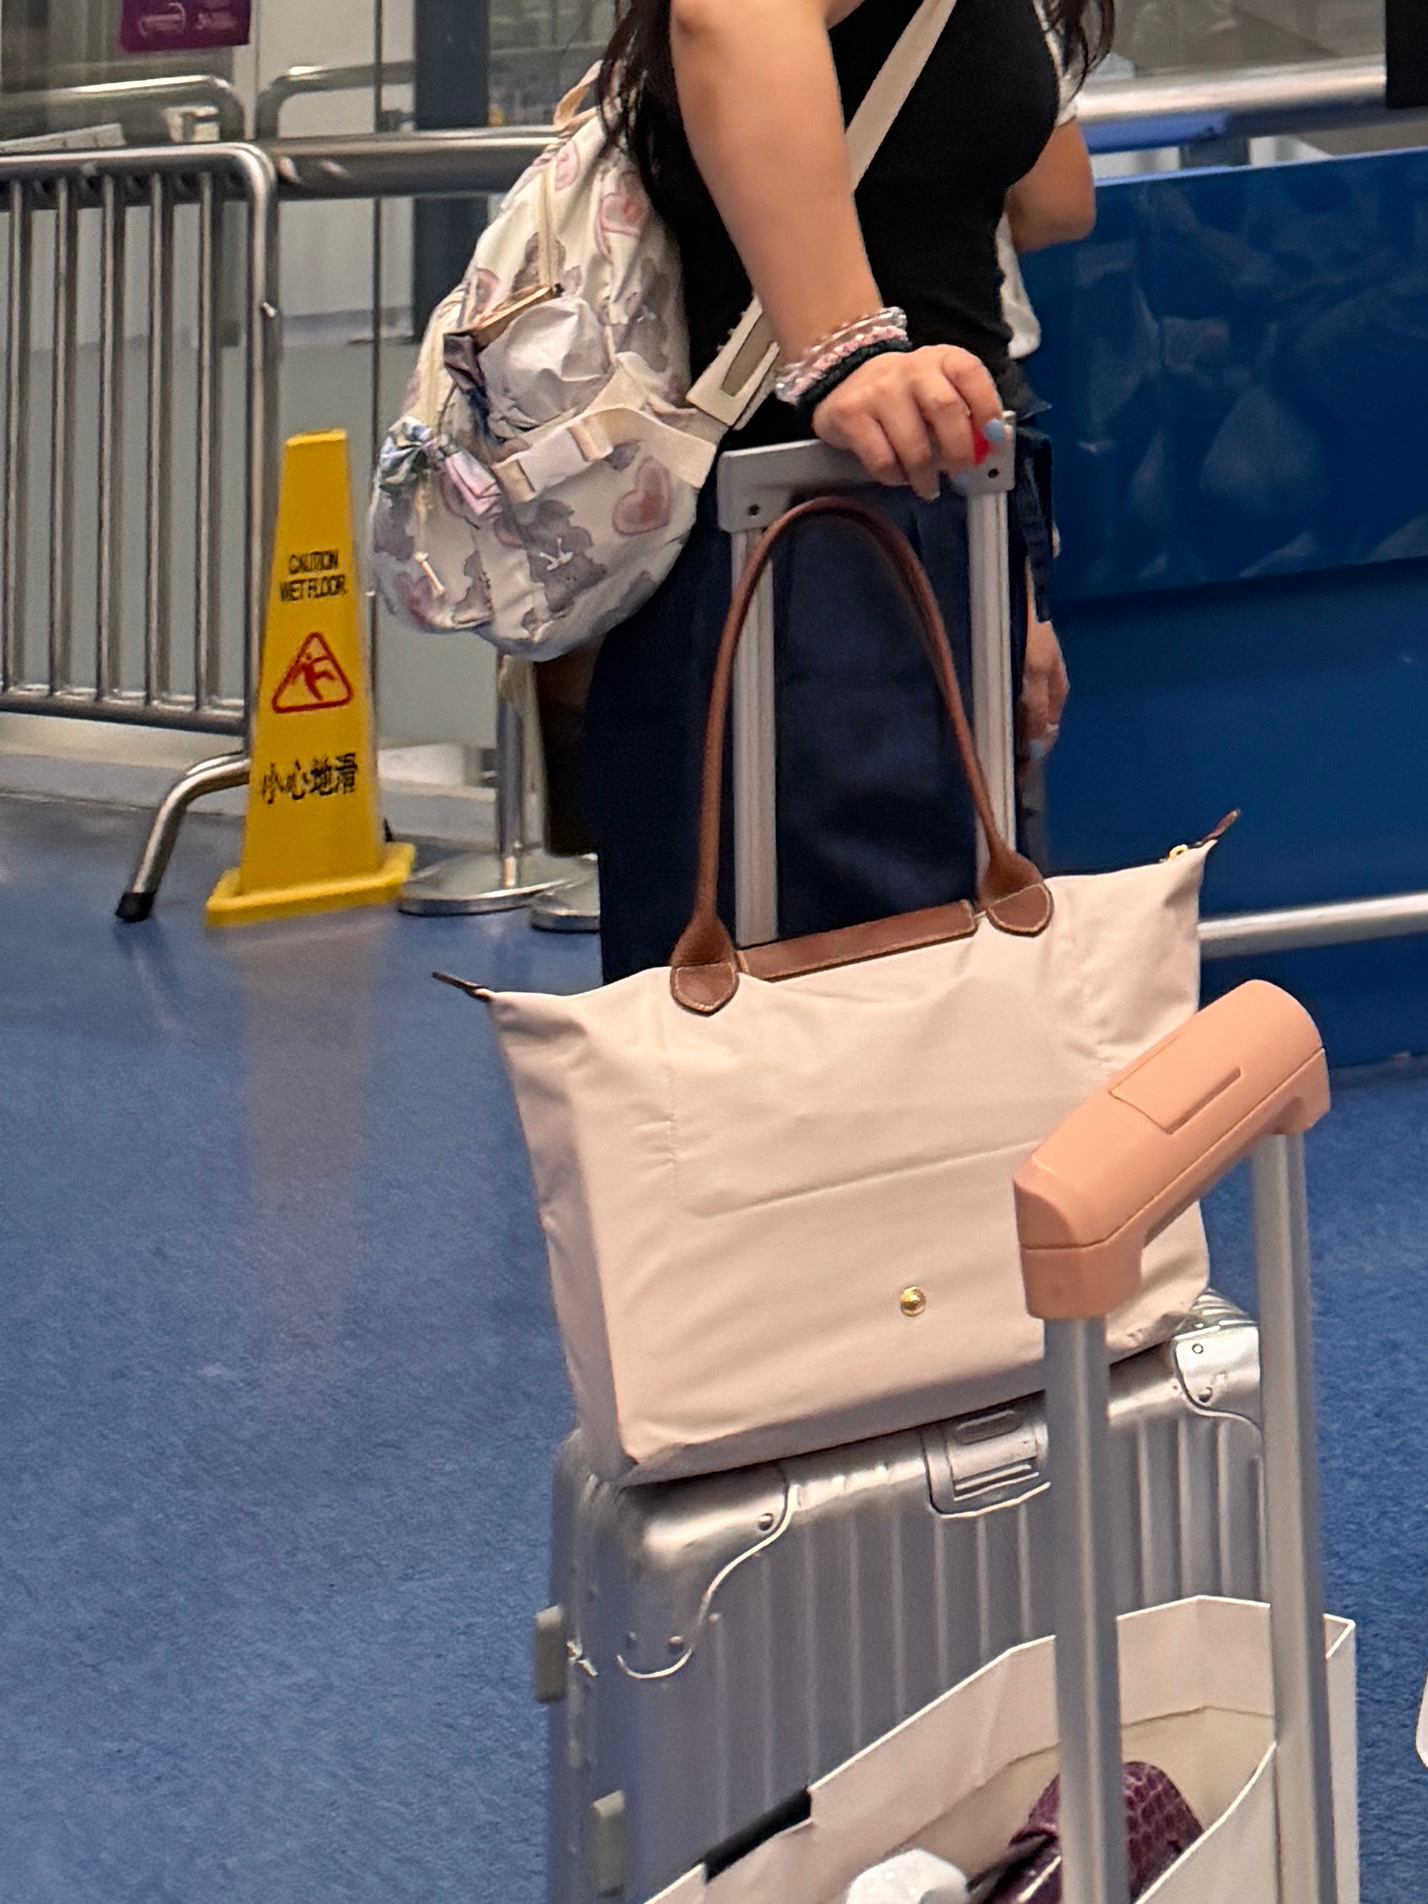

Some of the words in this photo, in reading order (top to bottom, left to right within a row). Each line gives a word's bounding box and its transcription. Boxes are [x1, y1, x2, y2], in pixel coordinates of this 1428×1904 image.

[288, 549, 339, 574] CAUTION
[281, 579, 305, 601] WET
[307, 574, 348, 599] FLOOR
[262, 752, 358, 805] 小心地滑
